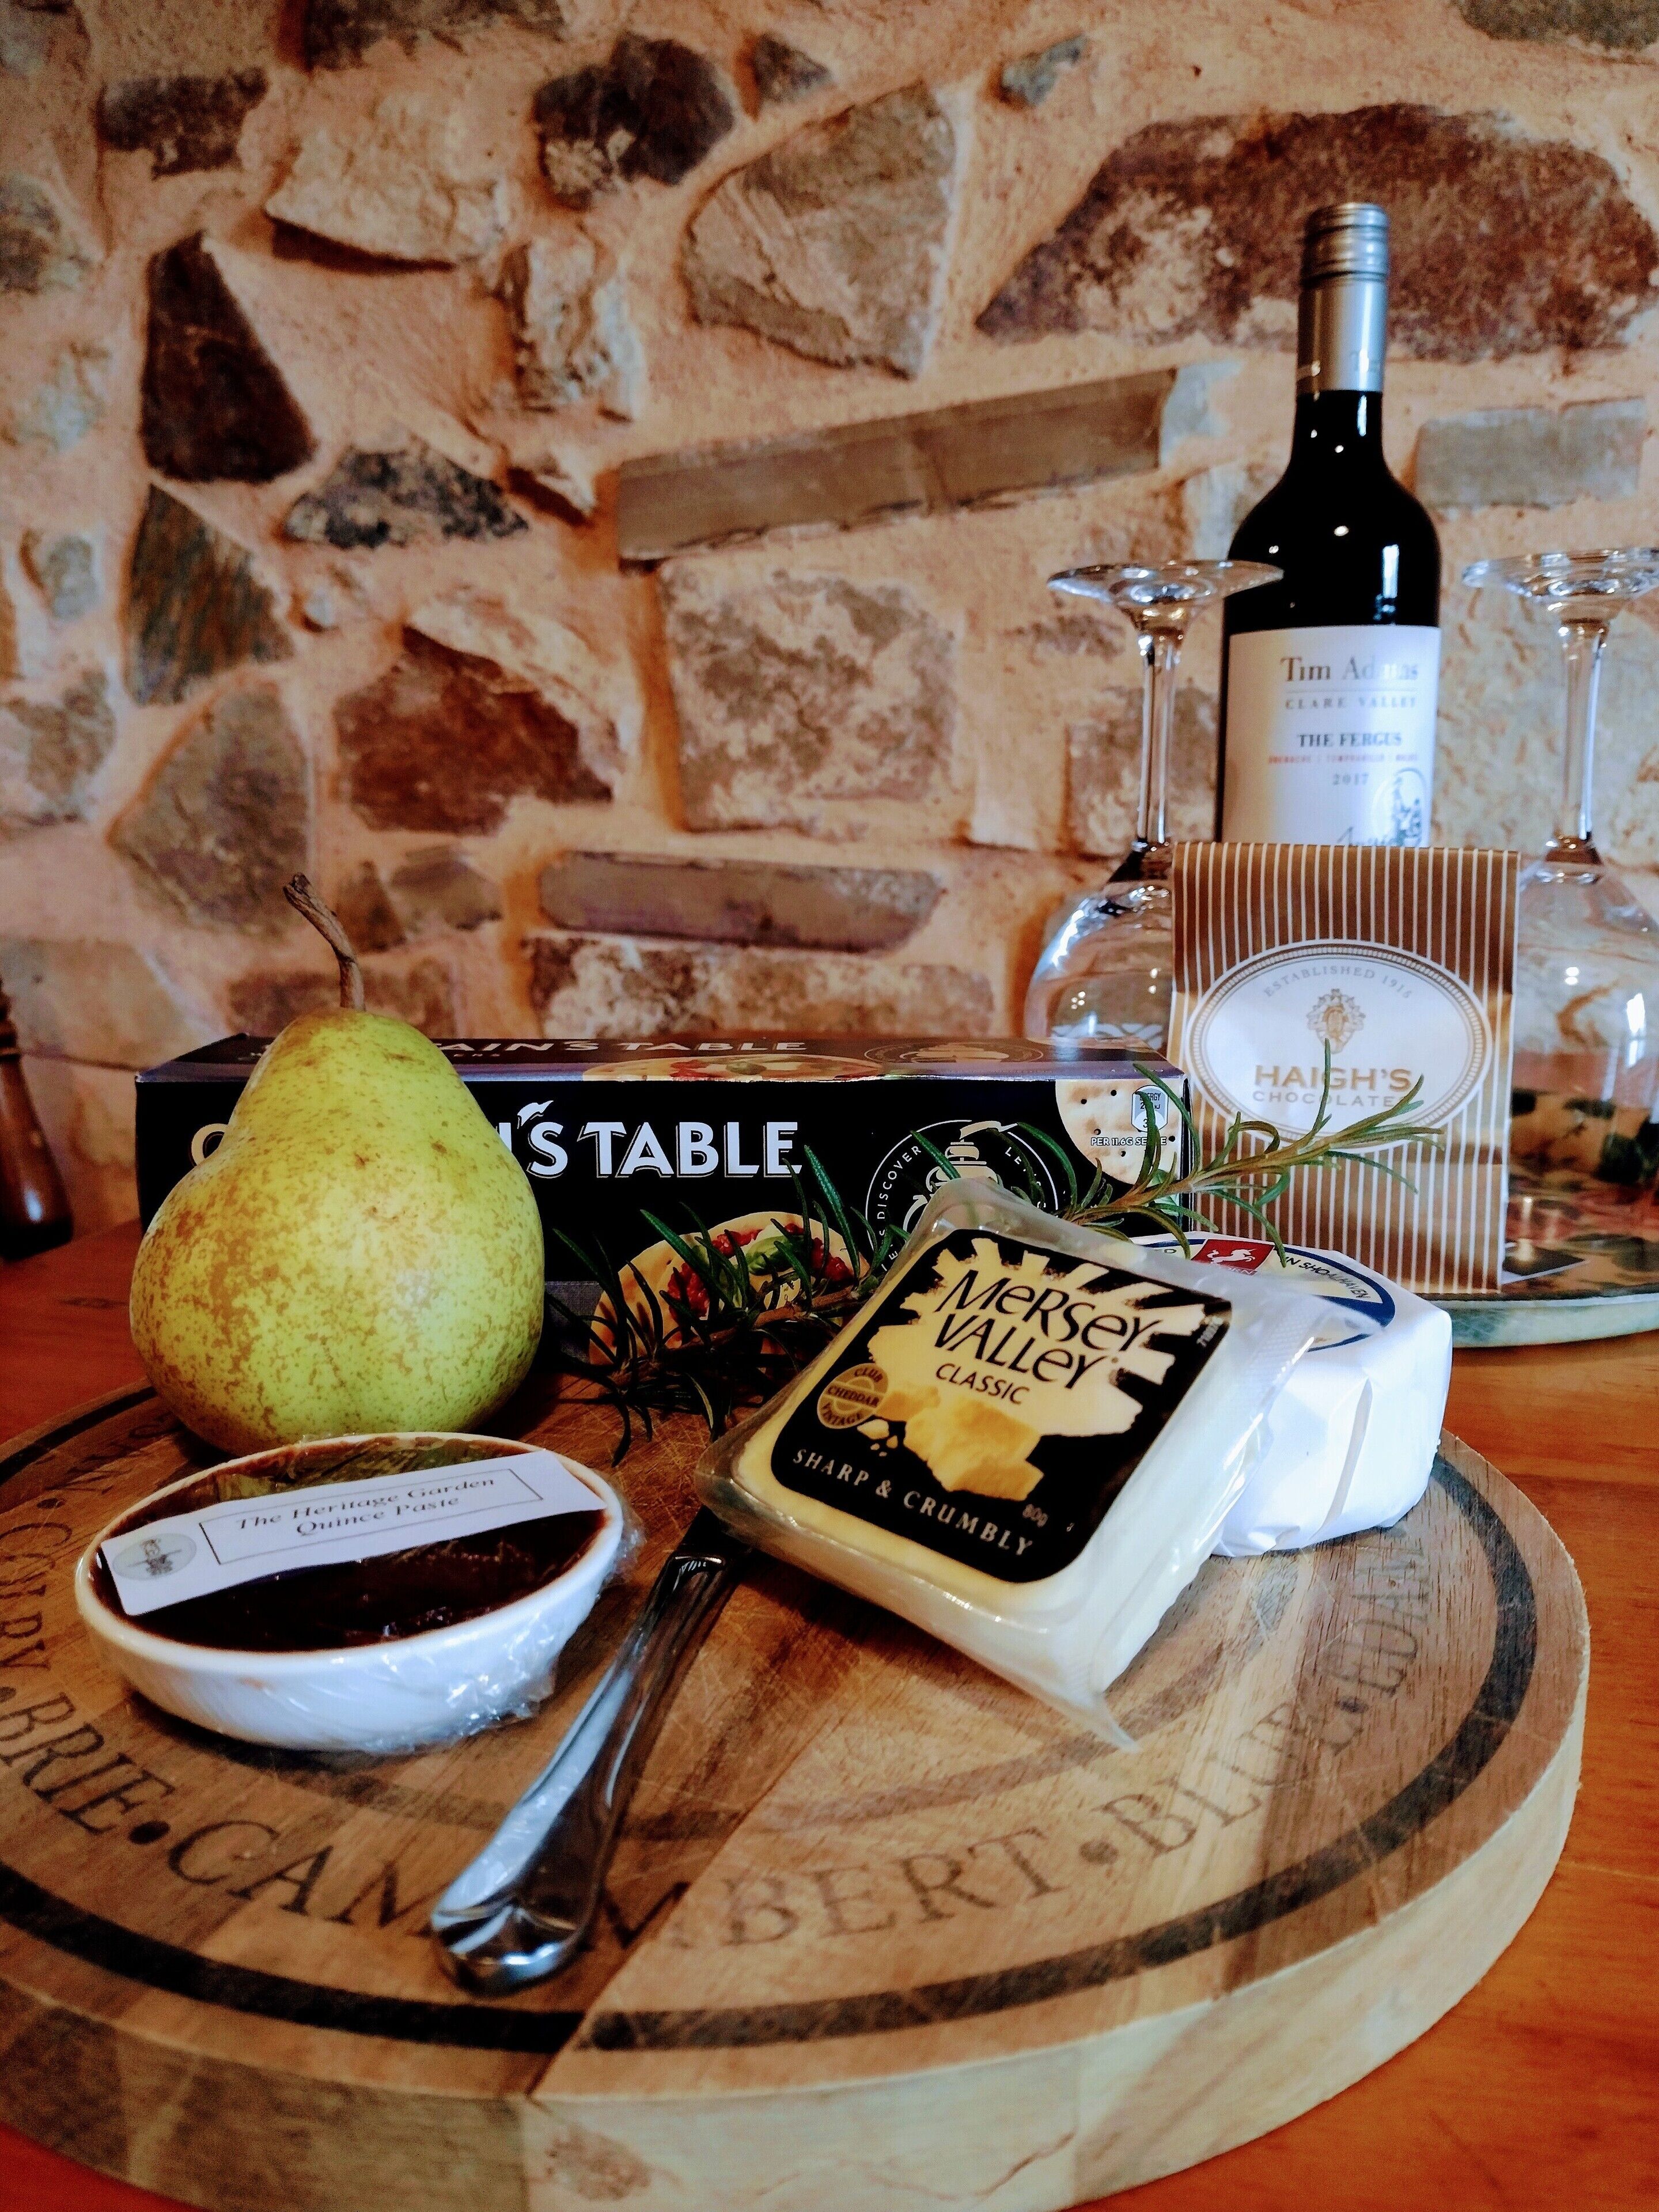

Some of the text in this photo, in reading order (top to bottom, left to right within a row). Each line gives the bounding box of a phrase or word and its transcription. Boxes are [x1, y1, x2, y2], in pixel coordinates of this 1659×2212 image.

[1279, 656, 1331, 682] Tim
[1298, 732, 1403, 748] THE FERGUS
[1264, 964, 1376, 998] ESTABLISHED
[618, 1040, 808, 1052] TABLE
[1255, 1065, 1411, 1092] HAIGH'S
[1252, 1090, 1406, 1108] CHOCOLATE
[577, 1121, 803, 1179] TABLE
[1090, 1137, 1167, 1146] PER 11.6G SEE
[877, 1145, 922, 1219] DISCOVER
[1298, 1262, 1371, 1298] SHOALHAVEN
[827, 1385, 880, 1408] CHEDDAR
[935, 1362, 1031, 1405] CLASSIC
[821, 1402, 863, 1426] VINTAGE
[237, 1478, 495, 1529] The Heritage Garden
[296, 1497, 460, 1536] Quince Paste
[792, 1448, 1033, 1556] SHARP & CRUMBLY
[0, 1692, 176, 1835] BRIE
